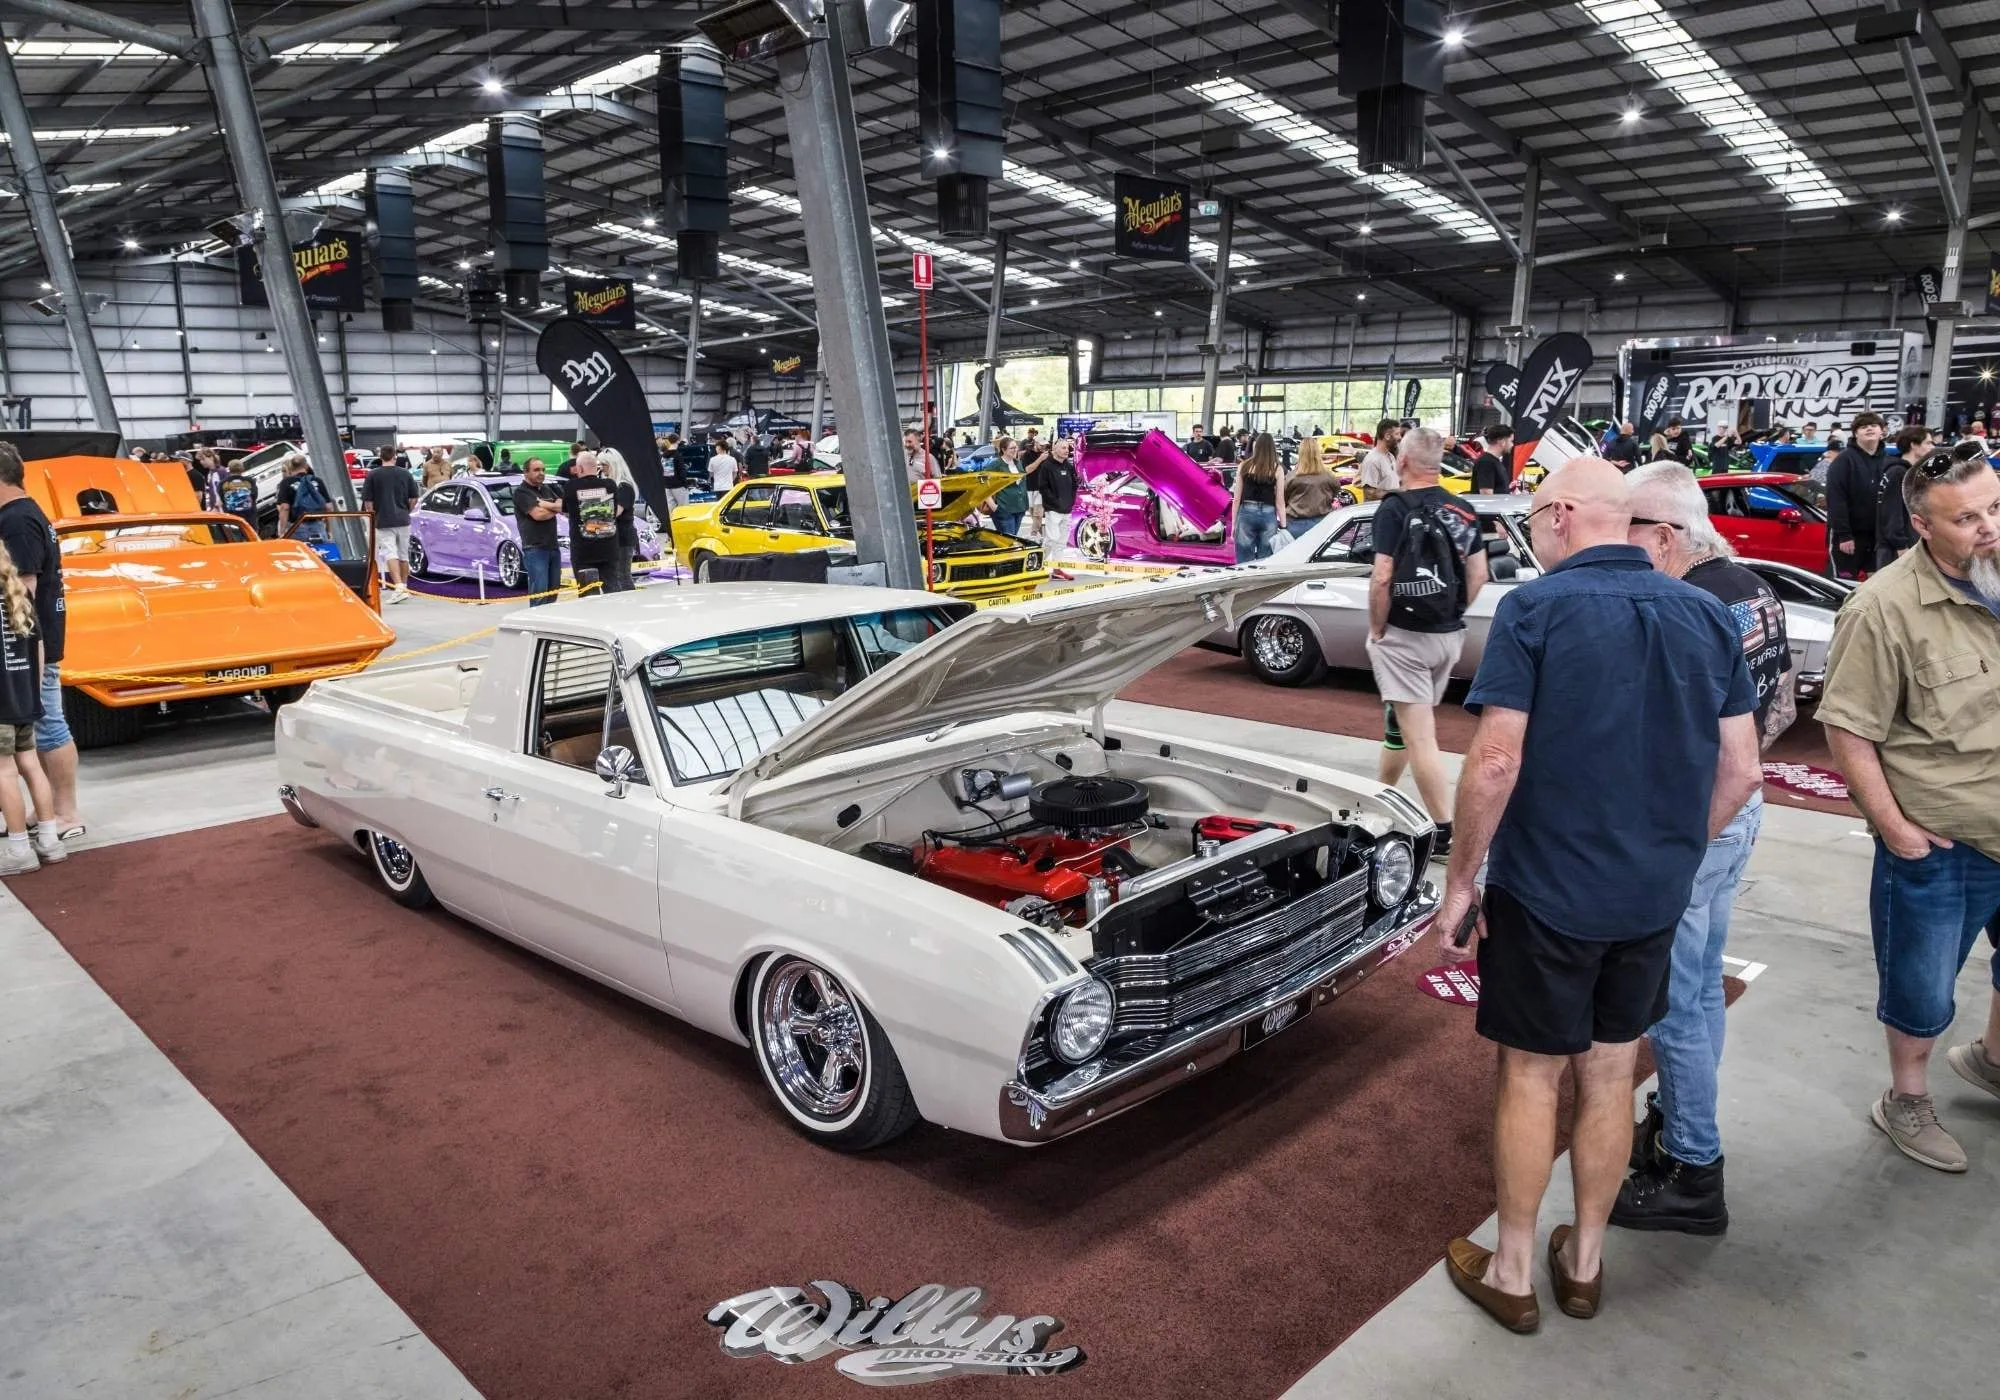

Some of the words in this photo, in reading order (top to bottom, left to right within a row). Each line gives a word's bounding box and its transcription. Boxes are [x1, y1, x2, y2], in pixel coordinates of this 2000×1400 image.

[1123, 190, 1183, 234] Meguiar's
[573, 283, 627, 314] Meguiar's
[1733, 355, 1809, 371] CASTLEMAINE
[988, 597, 1011, 607] CAUTION
[1022, 592, 1044, 602] CAUTION
[703, 1279, 1060, 1361] Willys
[877, 1348, 968, 1363] DROP
[974, 1350, 1063, 1366] SHOP
